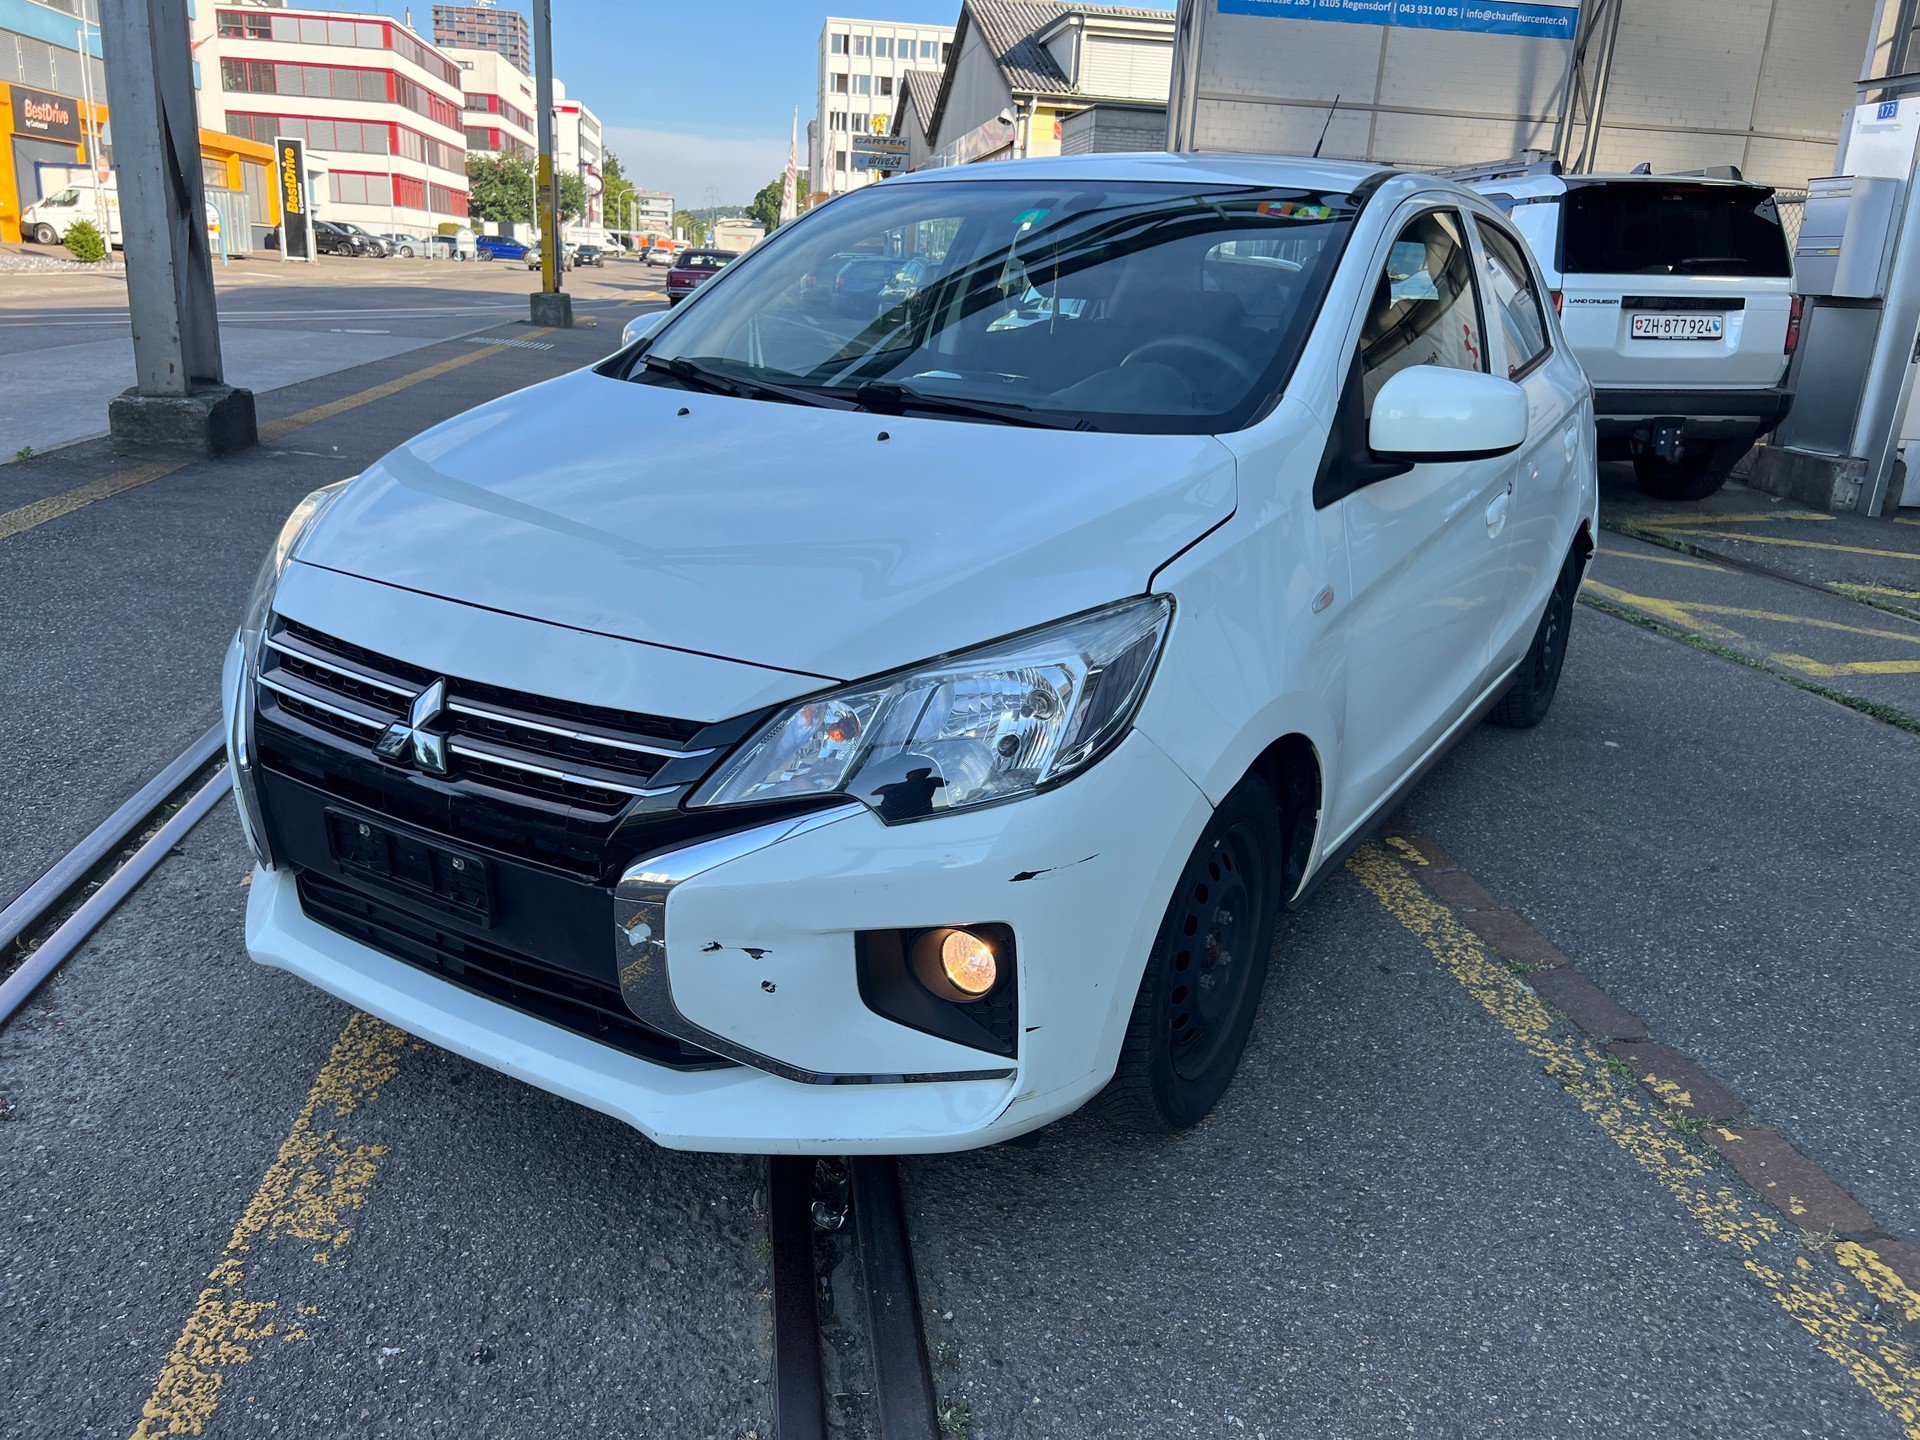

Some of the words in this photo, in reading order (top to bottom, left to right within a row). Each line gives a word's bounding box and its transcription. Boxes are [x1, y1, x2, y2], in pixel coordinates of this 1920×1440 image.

[1319, 0, 1340, 8] 8105
[1342, 0, 1391, 11] Regensdorf
[1399, 4, 1415, 14] 043
[1417, 5, 1433, 15] 931
[1434, 7, 1446, 16] 00
[1447, 8, 1458, 17] 85
[1466, 9, 1569, 26] info@chauffeurcenter.ch
[24, 98, 69, 125] BestDrive
[1880, 104, 1896, 117] 173
[854, 138, 907, 146] CARTEK
[281, 147, 299, 214] BestDrive
